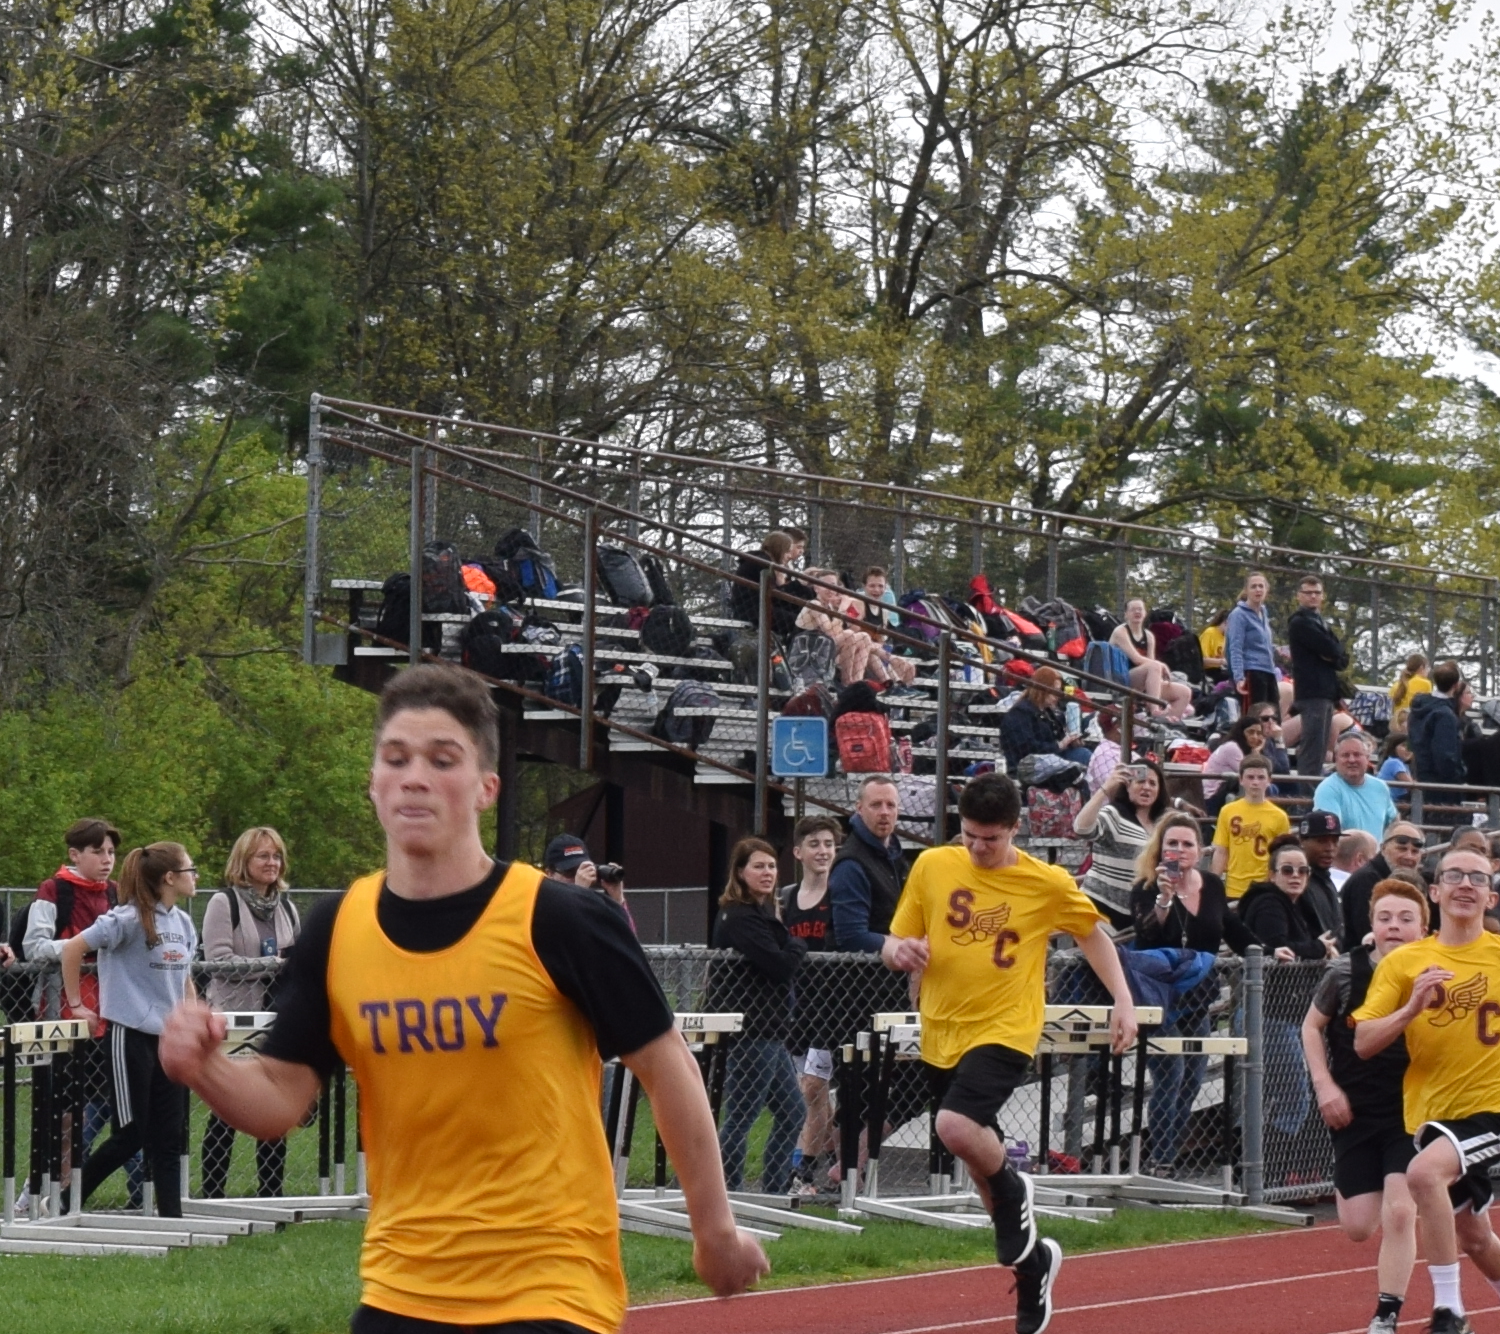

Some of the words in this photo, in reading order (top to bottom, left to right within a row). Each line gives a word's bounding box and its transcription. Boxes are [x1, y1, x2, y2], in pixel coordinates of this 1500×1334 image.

[1230, 815, 1243, 836] S
[1254, 835, 1267, 857] C
[947, 889, 974, 928] S
[993, 929, 1020, 968] C
[359, 993, 508, 1055] TROY
